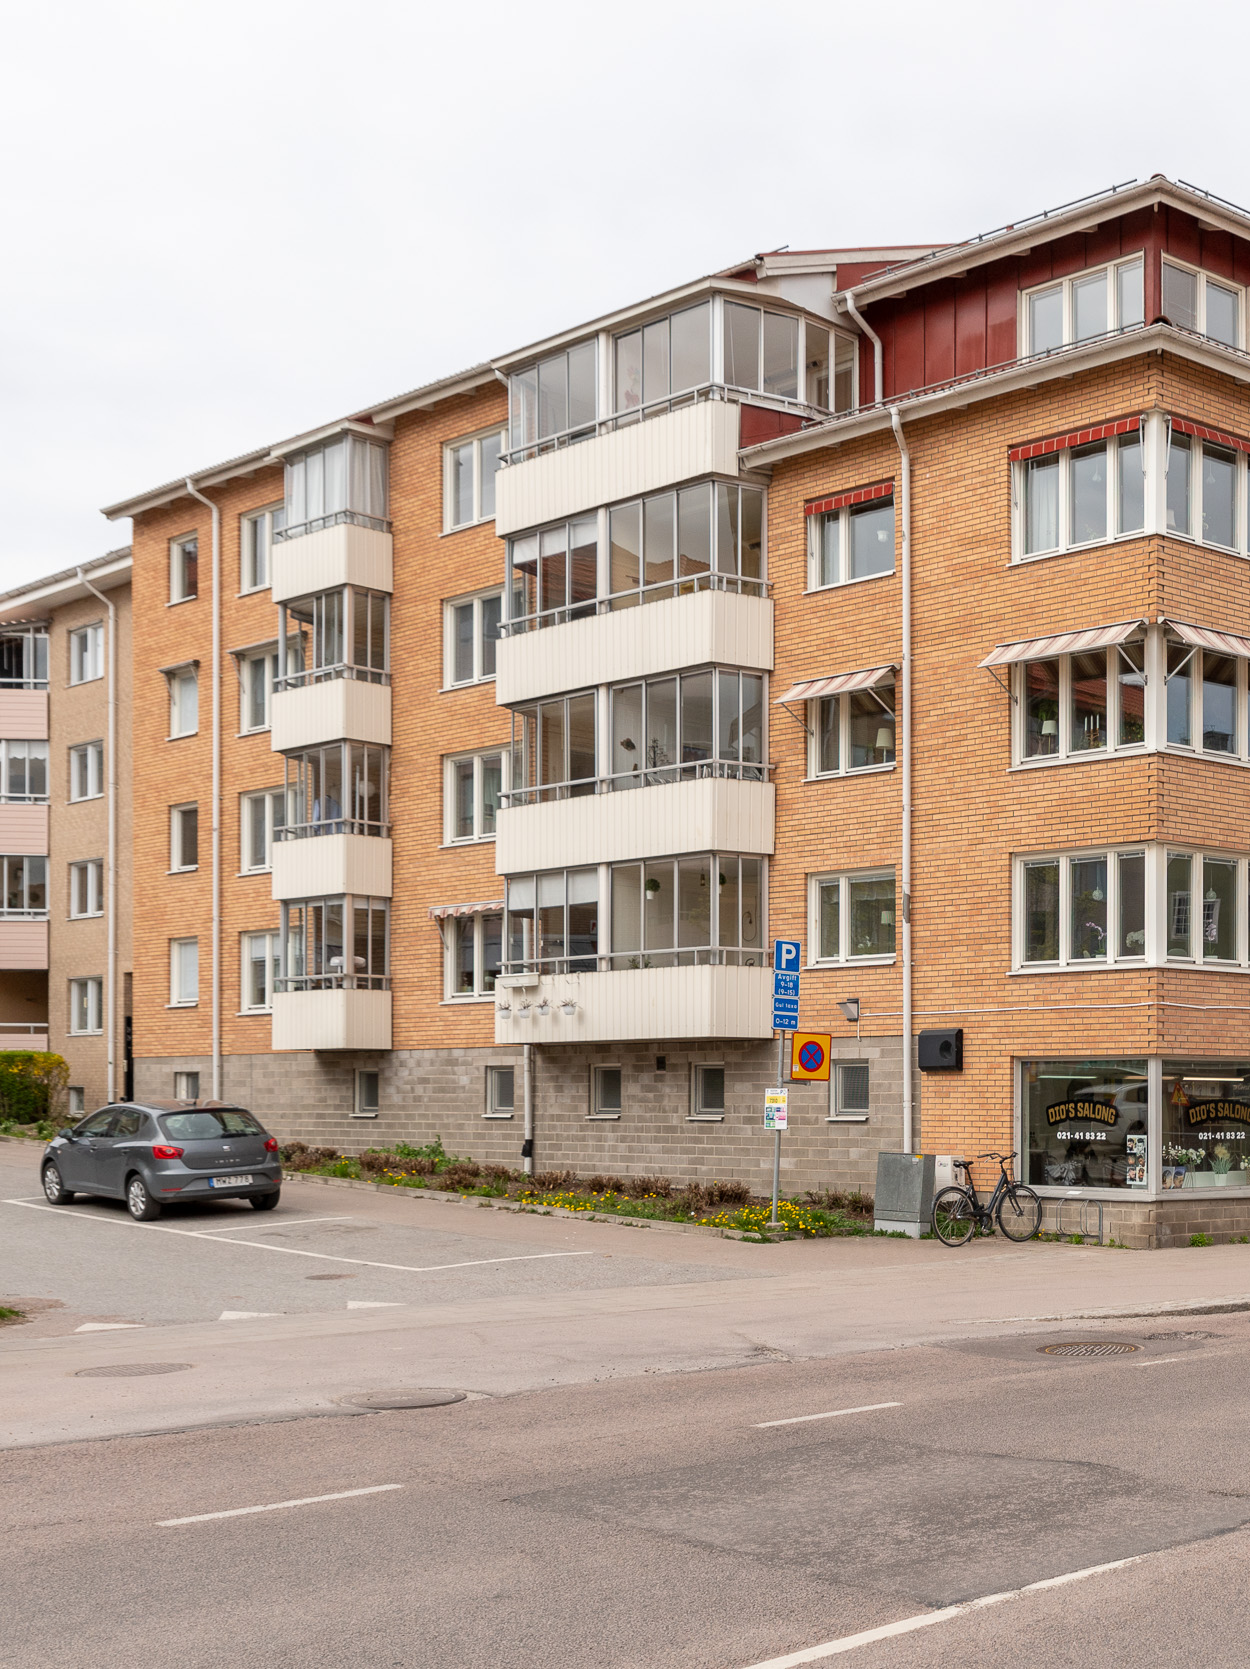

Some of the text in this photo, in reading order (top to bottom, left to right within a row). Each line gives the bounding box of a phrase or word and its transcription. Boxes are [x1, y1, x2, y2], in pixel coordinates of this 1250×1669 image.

[781, 943, 797, 969] P
[777, 973, 797, 982] Avgift
[778, 988, 796, 996] (9-15)
[1048, 1102, 1116, 1124] DIO'S SALONG
[1189, 1102, 1216, 1124] DIO'S
[1085, 1132, 1095, 1140] 83
[1096, 1132, 1107, 1140] 22
[1236, 1131, 1246, 1139] 22
[234, 1175, 249, 1184] 778
